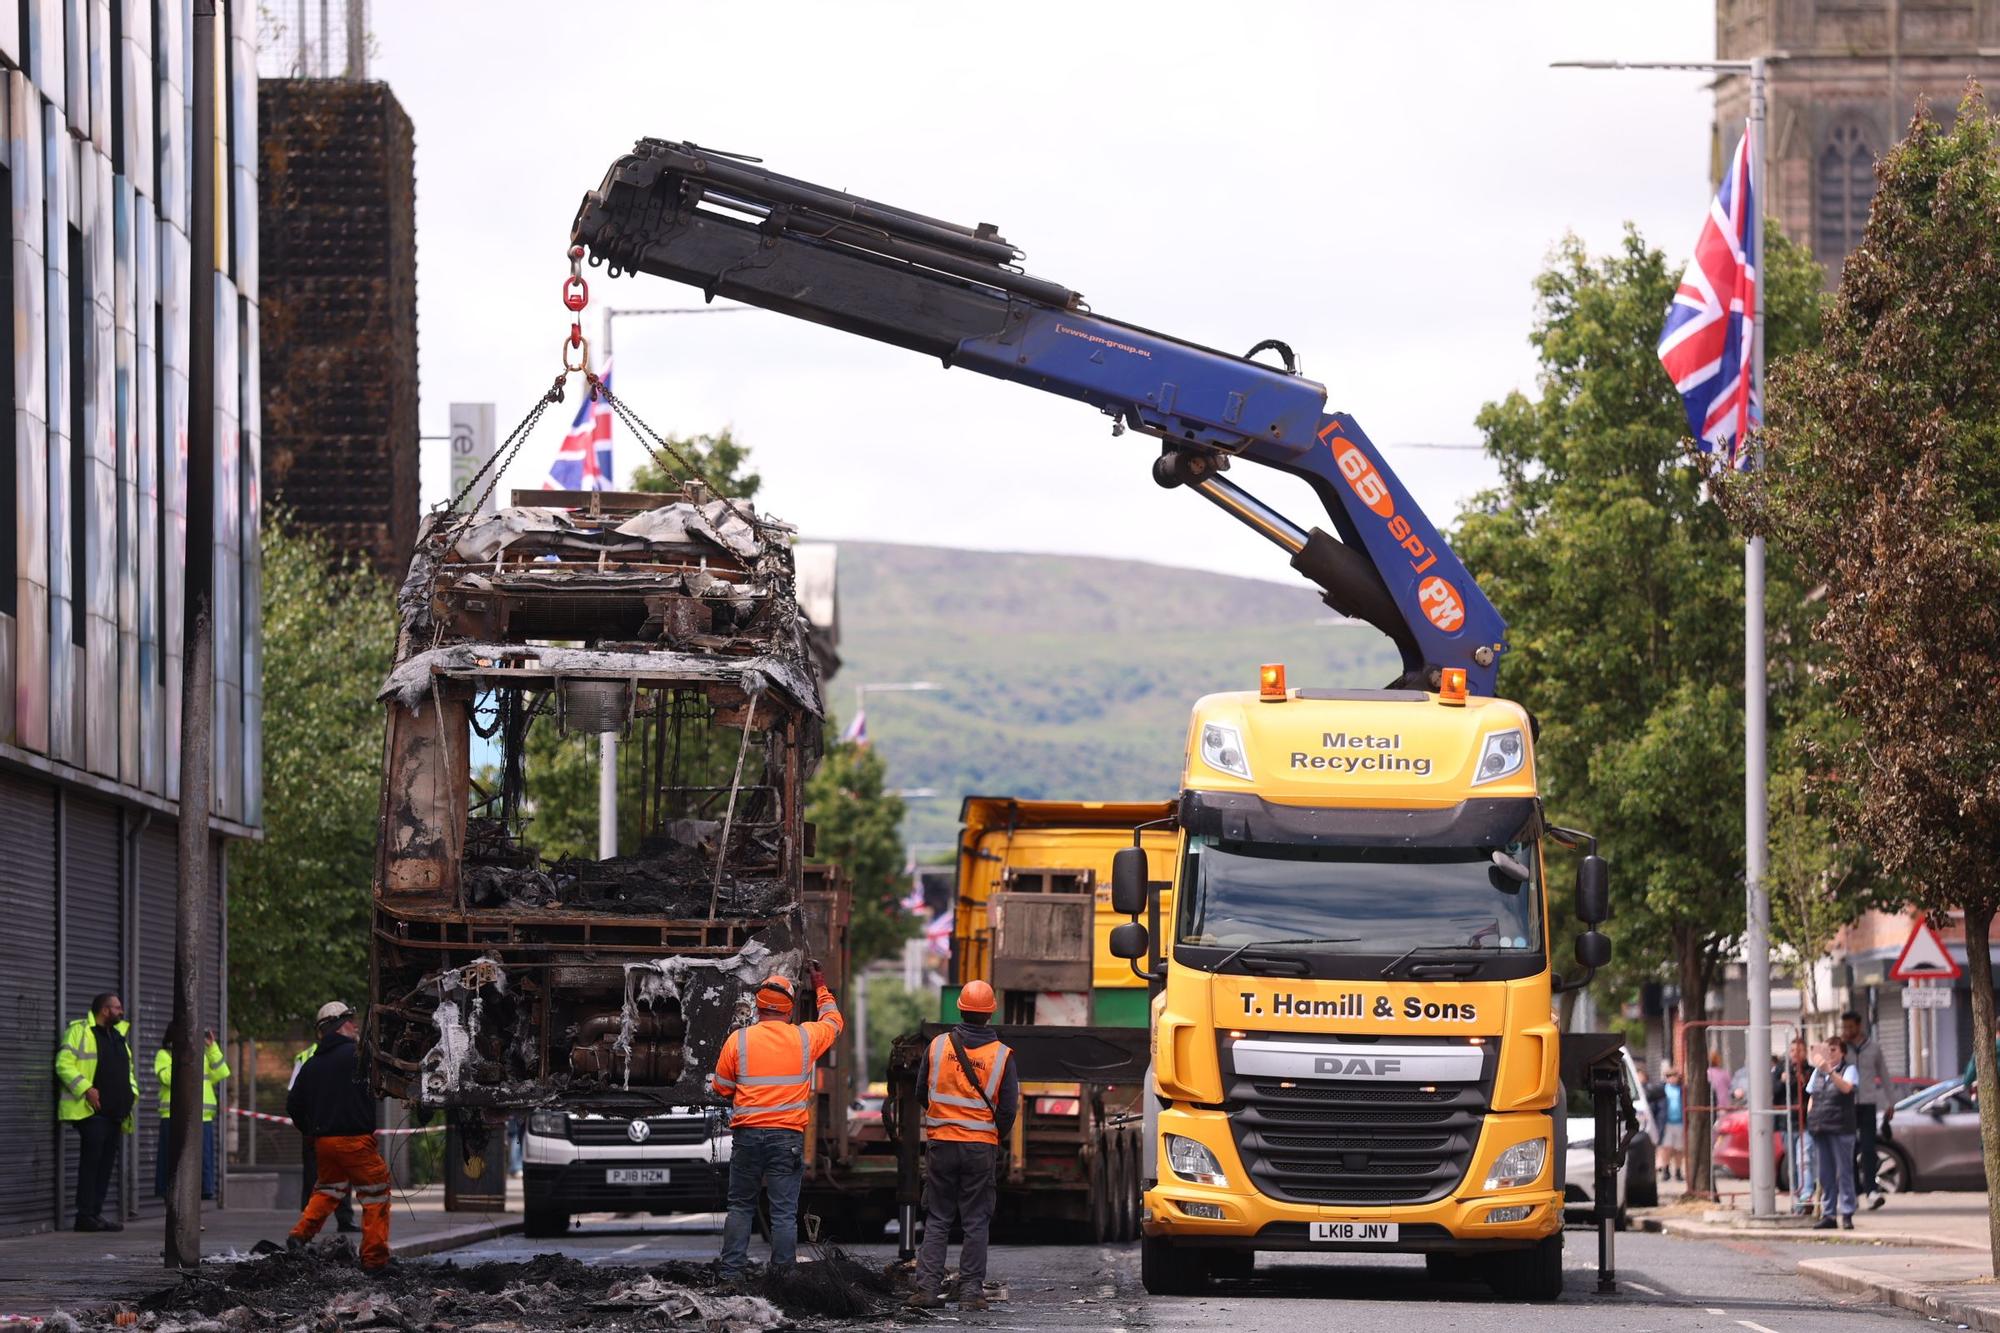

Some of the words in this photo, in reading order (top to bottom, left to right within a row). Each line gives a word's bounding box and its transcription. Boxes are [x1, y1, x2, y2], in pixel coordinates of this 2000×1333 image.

[1418, 577, 1464, 630] PM
[1322, 732, 1401, 750] Metal
[1290, 752, 1432, 776] Recycling
[1240, 992, 1263, 1015] T.
[1273, 993, 1363, 1017] Hamill
[1372, 995, 1395, 1018] &
[1403, 996, 1477, 1021] Sons
[1314, 1057, 1401, 1076] DAF
[1319, 1224, 1354, 1239] LK18
[1358, 1224, 1389, 1239] JNV
